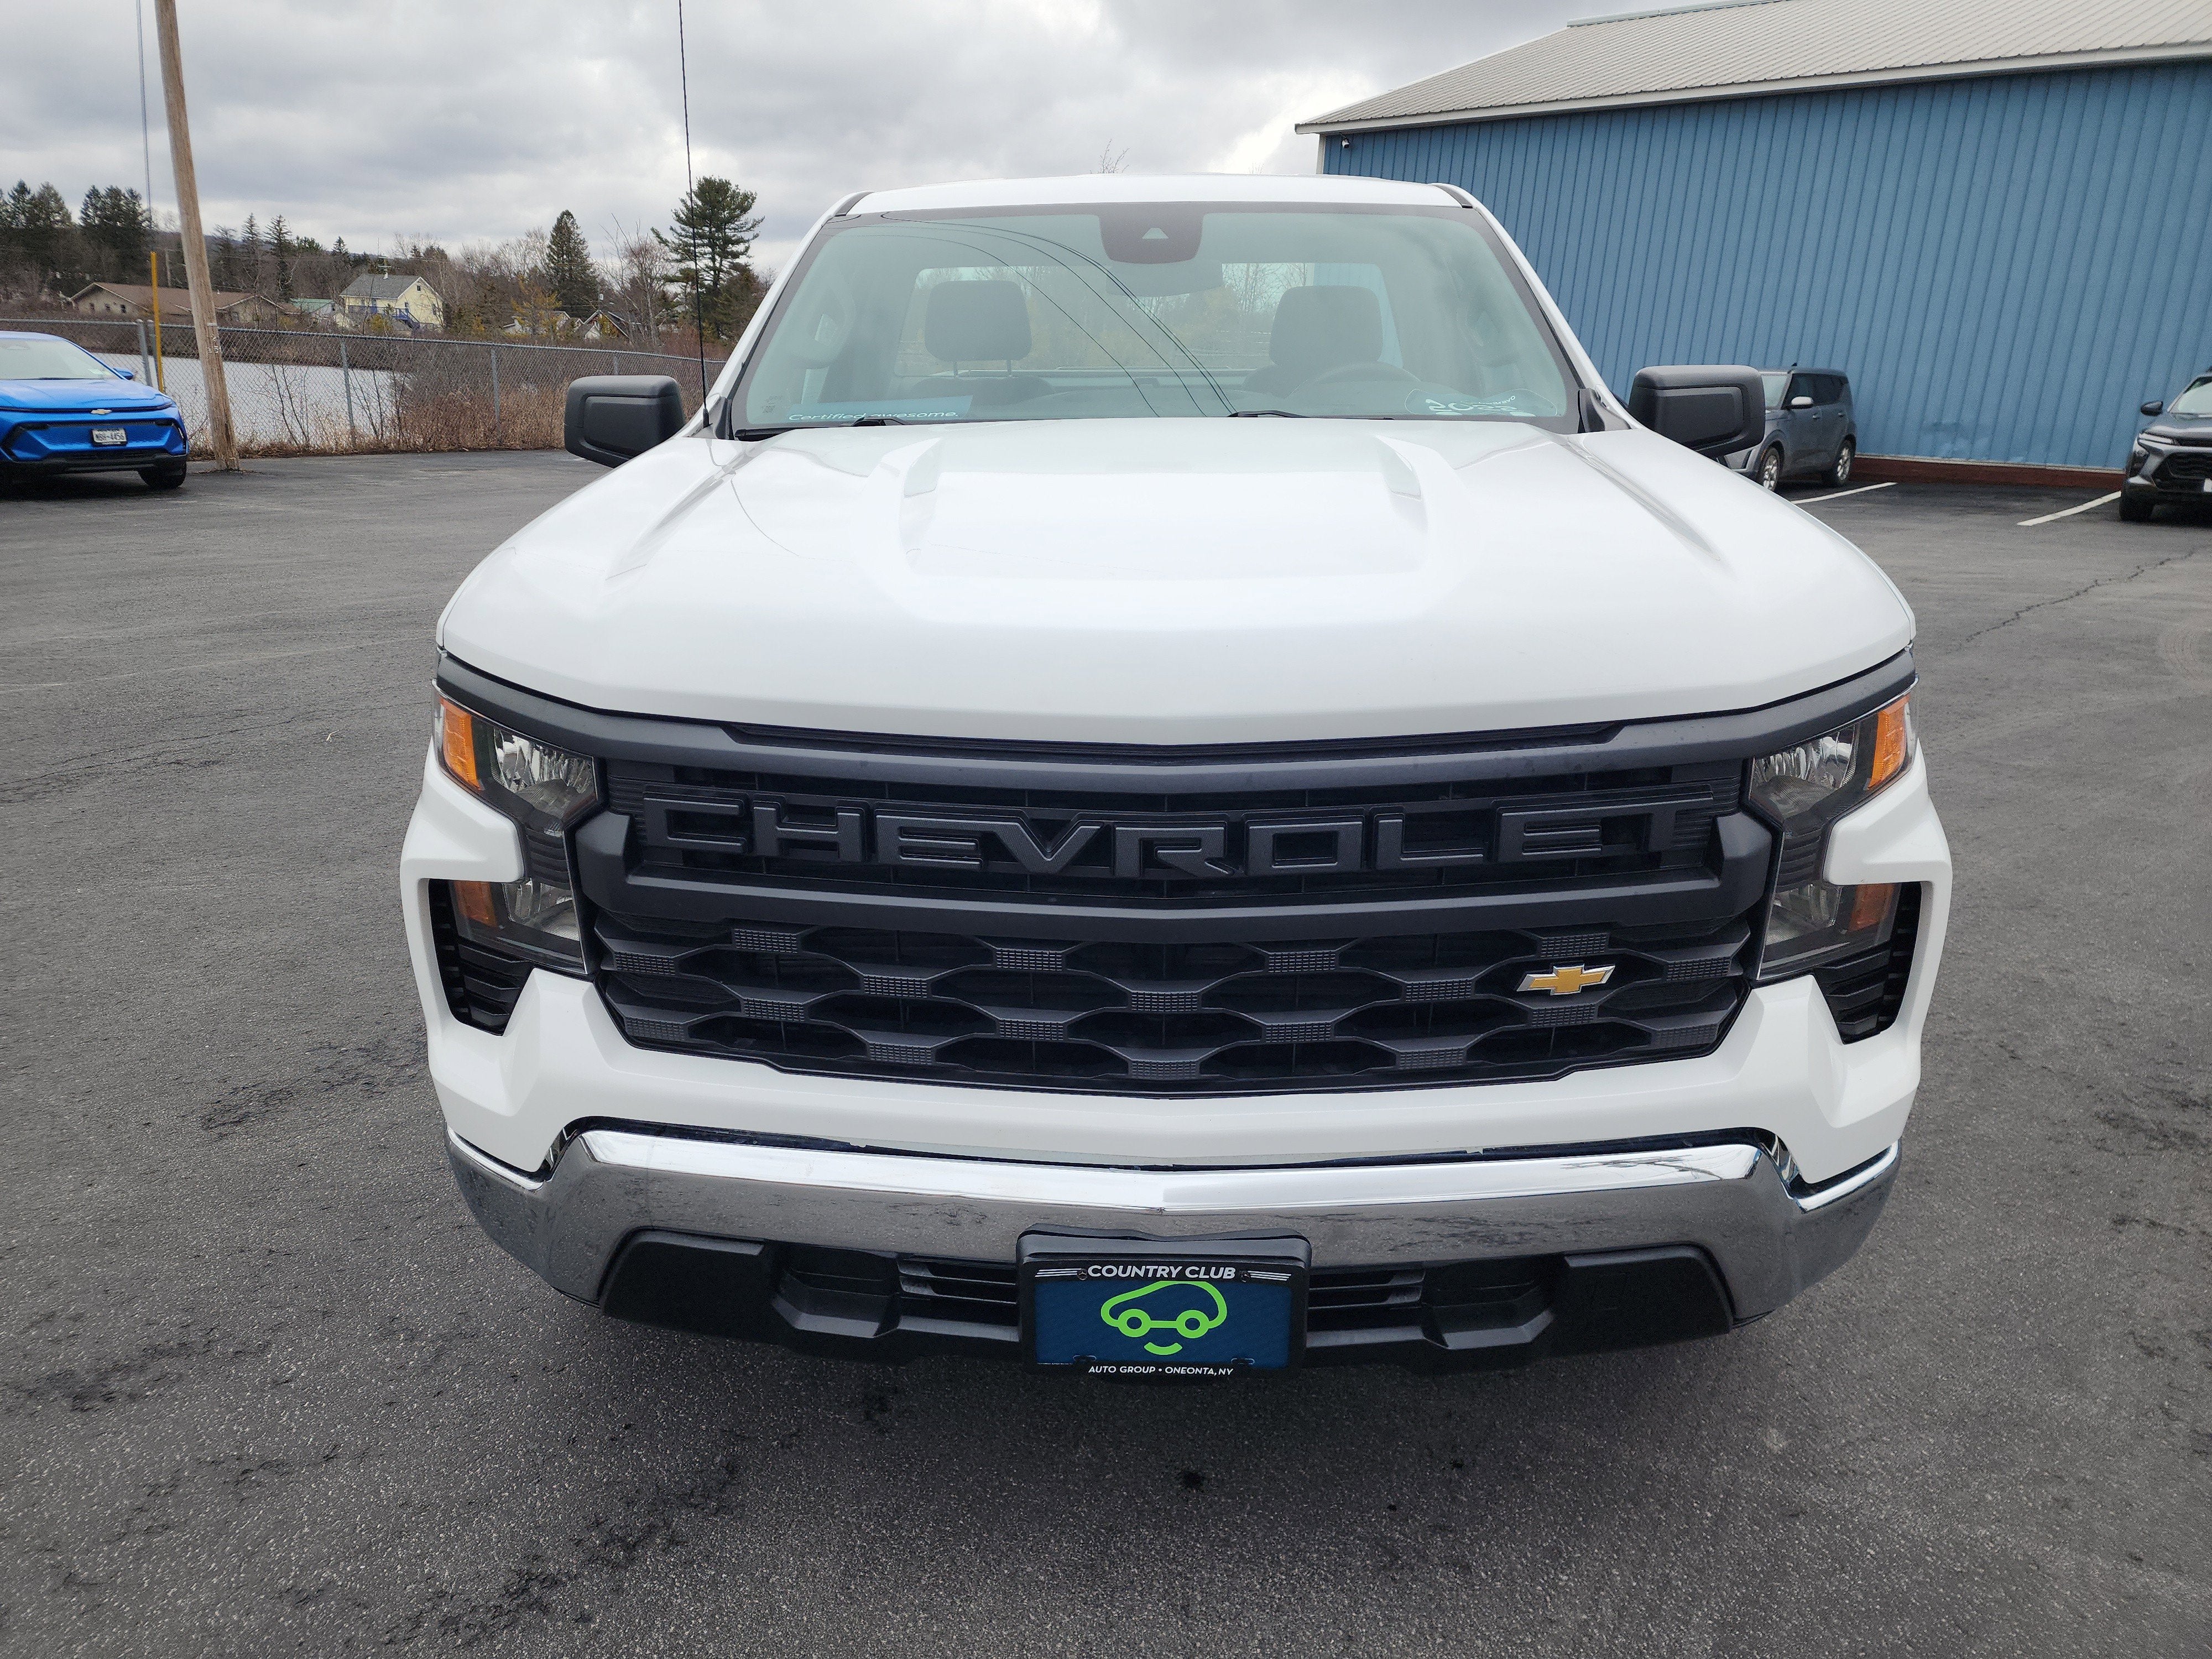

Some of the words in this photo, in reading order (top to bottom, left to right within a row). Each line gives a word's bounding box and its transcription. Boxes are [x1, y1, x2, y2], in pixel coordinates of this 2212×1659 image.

[643, 791, 1714, 878] CHEVROLET
[1088, 1265, 1182, 1278] COUNTRY
[1185, 1266, 1235, 1279] CLUB
